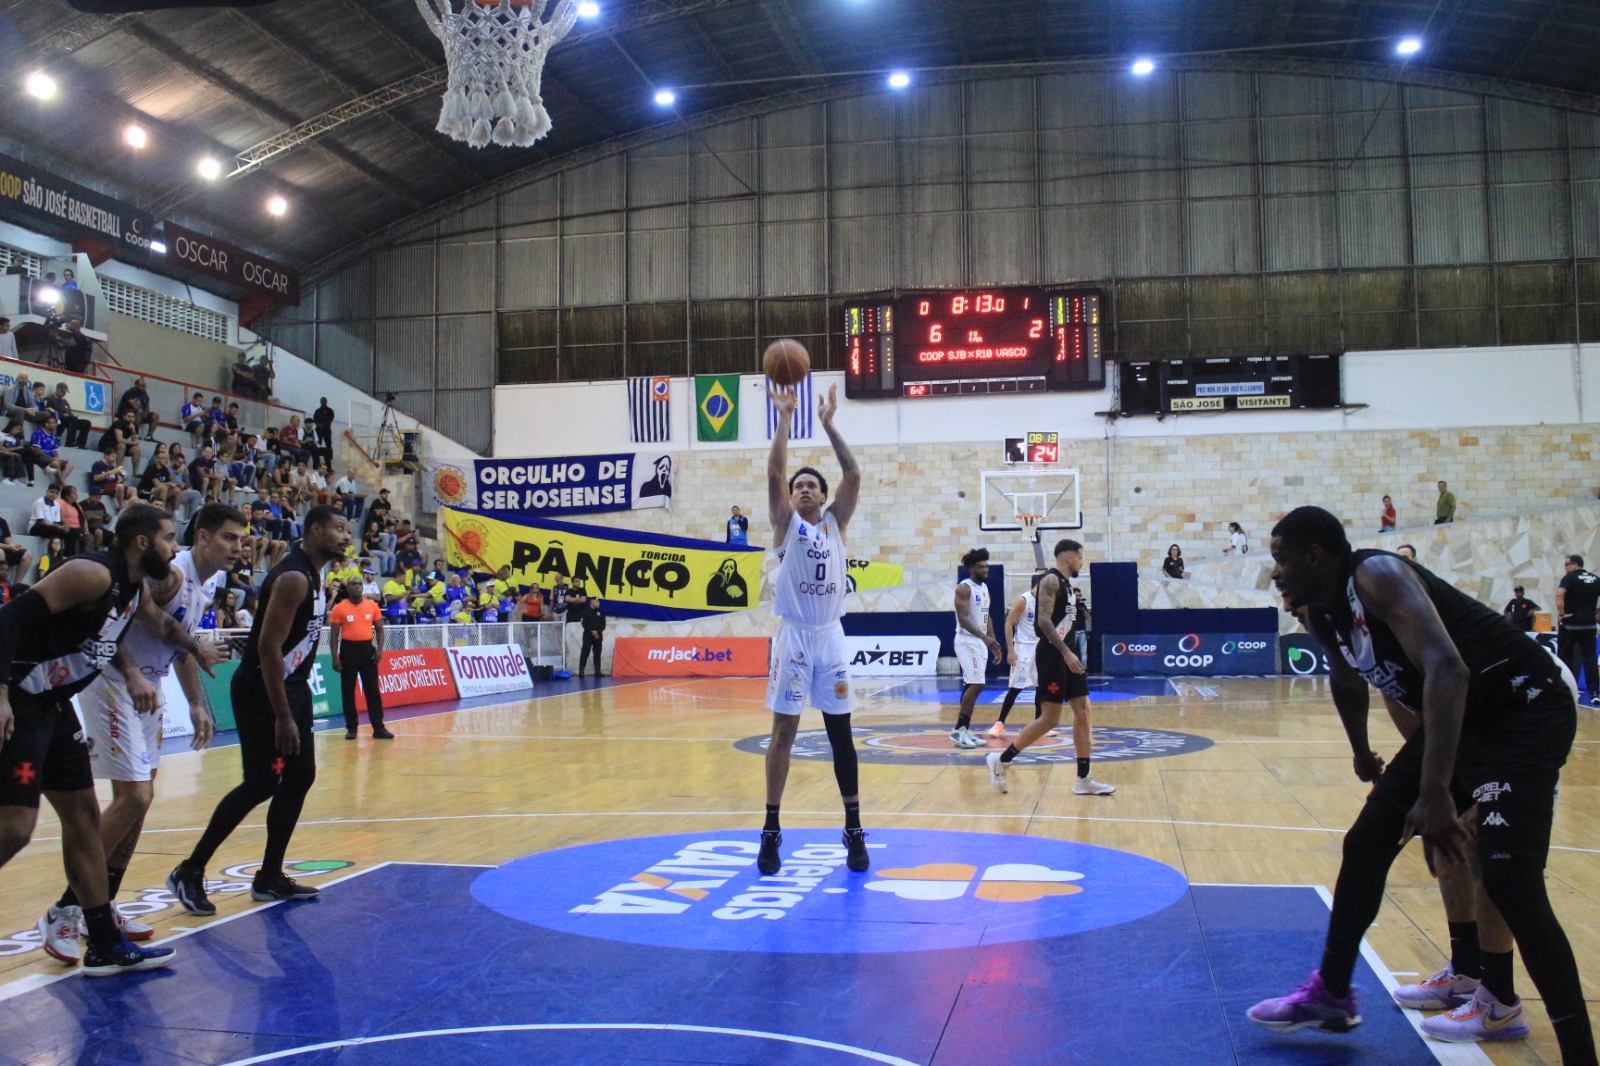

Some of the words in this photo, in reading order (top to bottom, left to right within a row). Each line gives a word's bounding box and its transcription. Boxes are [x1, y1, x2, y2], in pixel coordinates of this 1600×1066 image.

[0, 171, 21, 200] OOP
[23, 177, 42, 208] SÃO
[45, 190, 68, 218] JOSÉ
[68, 199, 121, 239] BASKETBALL
[125, 232, 149, 249] COOP
[176, 237, 228, 273] OSCAR
[243, 262, 288, 295] OSCAR
[920, 302, 929, 315] 0
[1024, 297, 1029, 310] 1
[930, 325, 942, 342] 6
[1030, 320, 1043, 338] 2
[920, 352, 945, 361] COOP
[948, 351, 966, 360] SJB
[976, 350, 993, 358] R10
[996, 348, 1027, 357] VASCO
[1173, 400, 1194, 409] SÃO
[1197, 399, 1222, 408] JOSÉ
[1239, 398, 1288, 406] VISITANTE
[1029, 433, 1057, 443] 08:13
[1034, 446, 1056, 461] 24
[480, 463, 586, 486] ORGULHO
[598, 460, 628, 481] DE
[481, 489, 520, 510] SER
[523, 484, 626, 509] JOSEENSE
[640, 550, 686, 563] TORCIDA
[511, 540, 691, 598] PÂNICO
[815, 563, 826, 581] 0
[799, 581, 836, 596] OSCAR
[1128, 644, 1157, 652] COOP
[1237, 641, 1267, 649] COOP
[389, 654, 426, 671] SHOPPING
[450, 645, 527, 680] Tomovale
[1163, 655, 1213, 667] COOP
[378, 672, 410, 694] JARDIM
[409, 668, 448, 688] ORIENTE
[1472, 781, 1511, 798] ESTRELA
[567, 840, 762, 914] CAIXA
[712, 843, 887, 920] loterias
